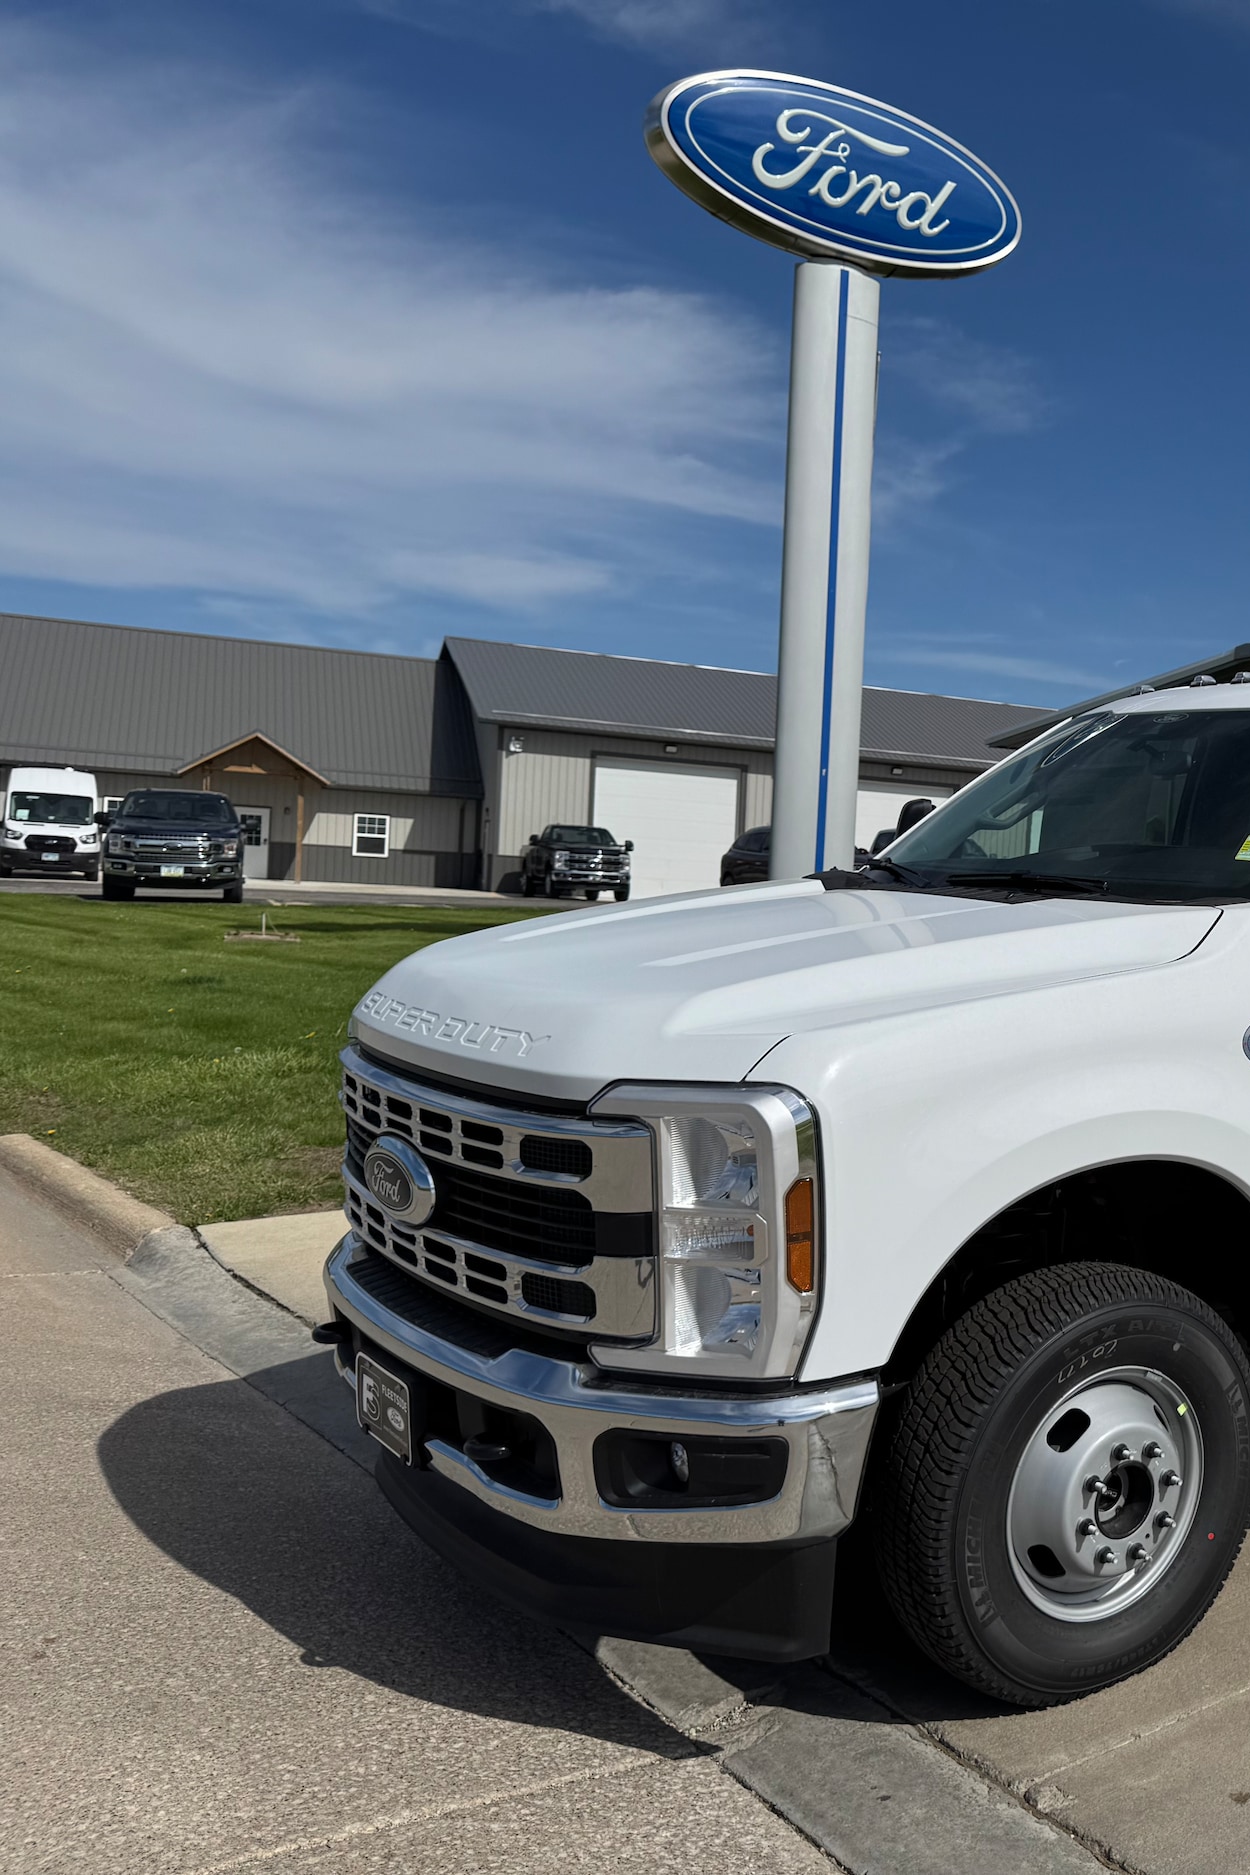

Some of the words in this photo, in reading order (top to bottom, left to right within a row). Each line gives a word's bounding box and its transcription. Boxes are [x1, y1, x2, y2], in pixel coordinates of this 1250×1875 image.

[752, 108, 957, 237] Ford
[361, 991, 440, 1036] SUPER
[434, 1016, 552, 1057] DUTY
[371, 1160, 402, 1203] Ford
[382, 1384, 408, 1413] FLEETSIDE
